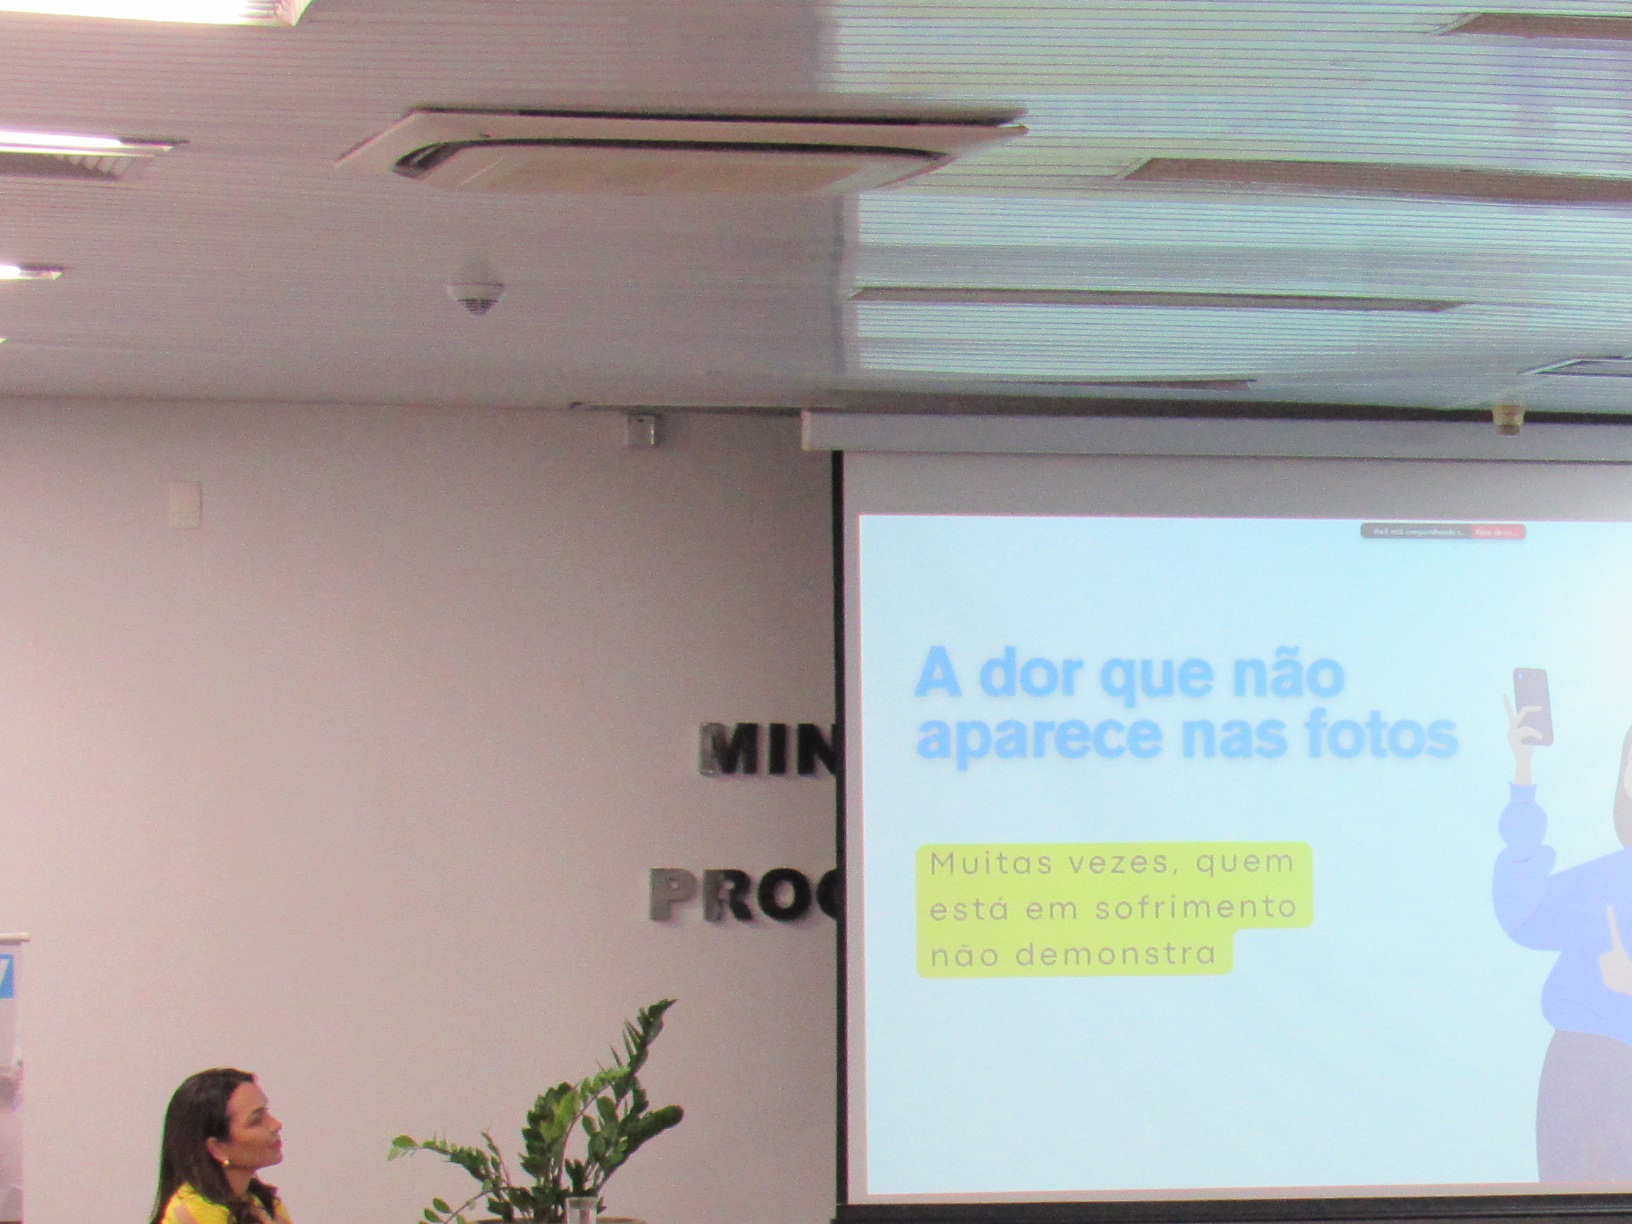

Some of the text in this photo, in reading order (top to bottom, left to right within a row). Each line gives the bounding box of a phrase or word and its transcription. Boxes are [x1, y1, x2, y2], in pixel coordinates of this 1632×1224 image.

[915, 646, 1345, 708] A dor que não
[917, 707, 1460, 771] aparece nas fotos
[930, 851, 1294, 878] Muitas vezes, quem
[929, 894, 1296, 922] está em sofrimento
[931, 941, 1216, 967] não demonstra
